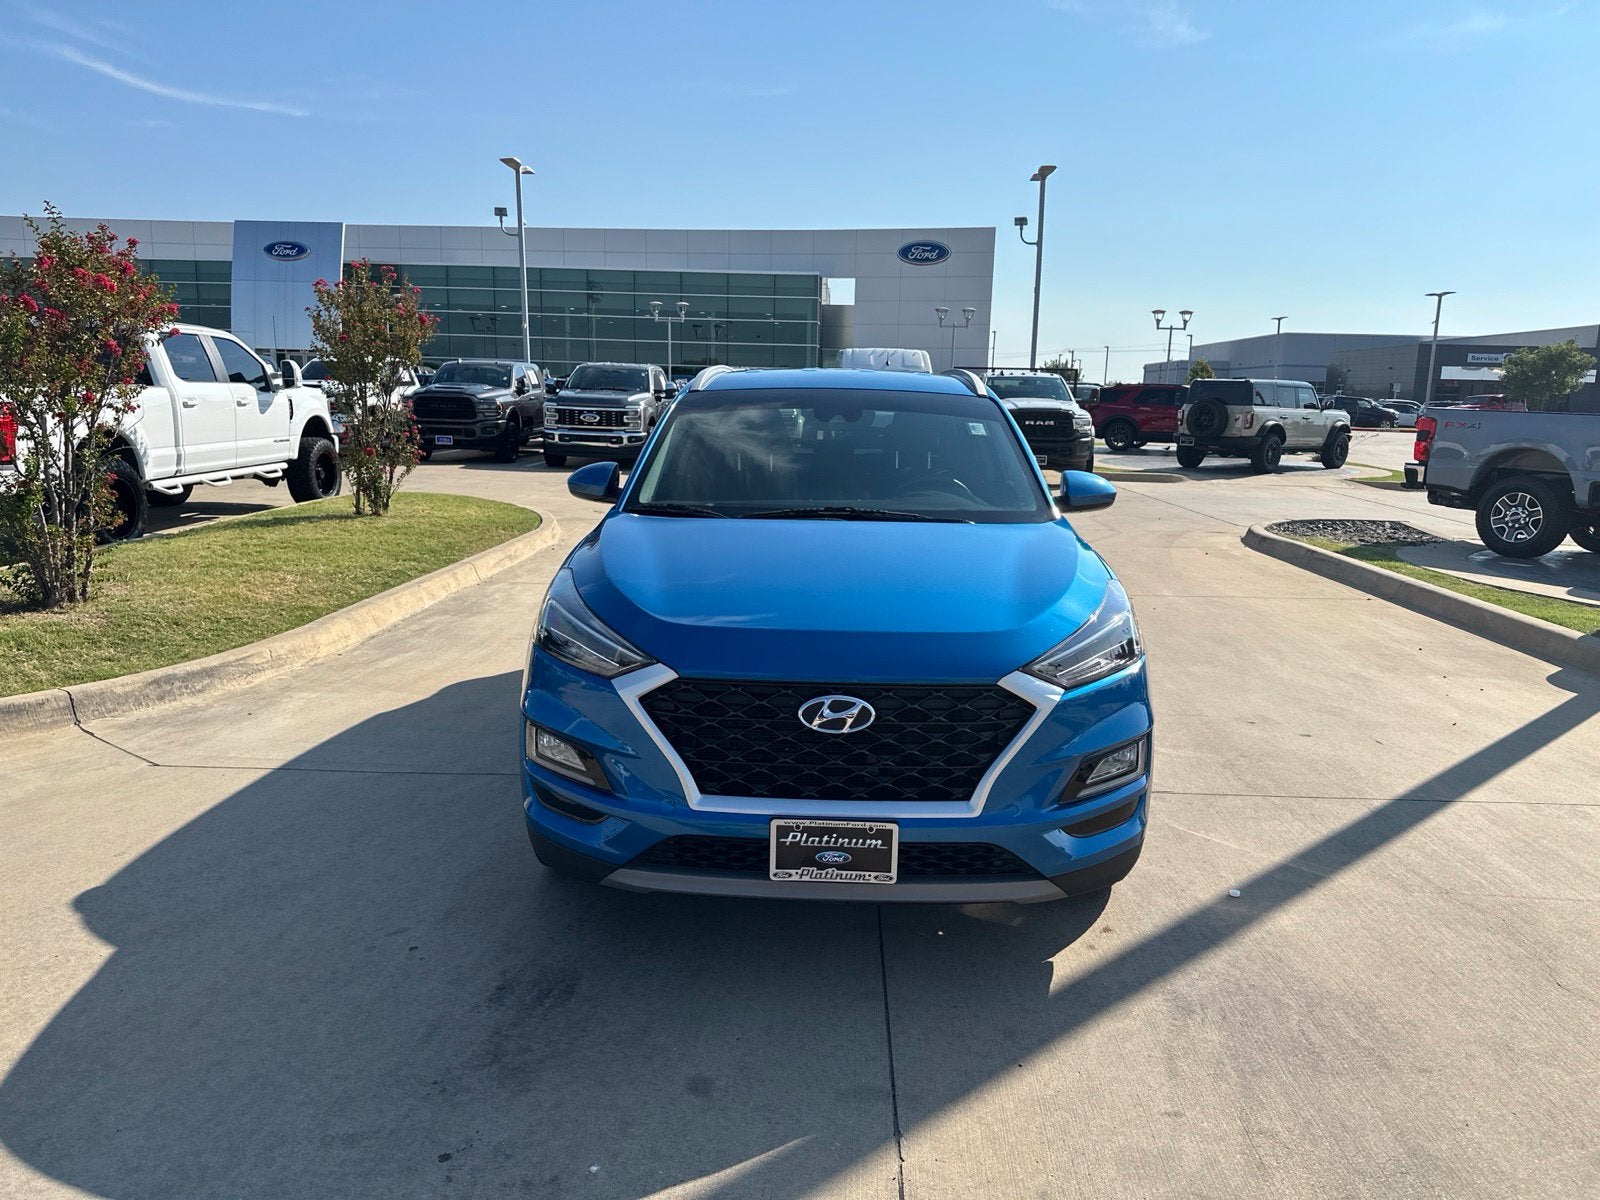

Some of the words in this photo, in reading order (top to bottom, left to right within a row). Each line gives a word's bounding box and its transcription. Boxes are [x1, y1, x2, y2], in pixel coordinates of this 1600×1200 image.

[272, 244, 298, 256] Ford
[908, 245, 939, 260] Ford
[780, 832, 888, 849] Platinum
[822, 852, 845, 862] Ford
[799, 867, 871, 881] Platinum
